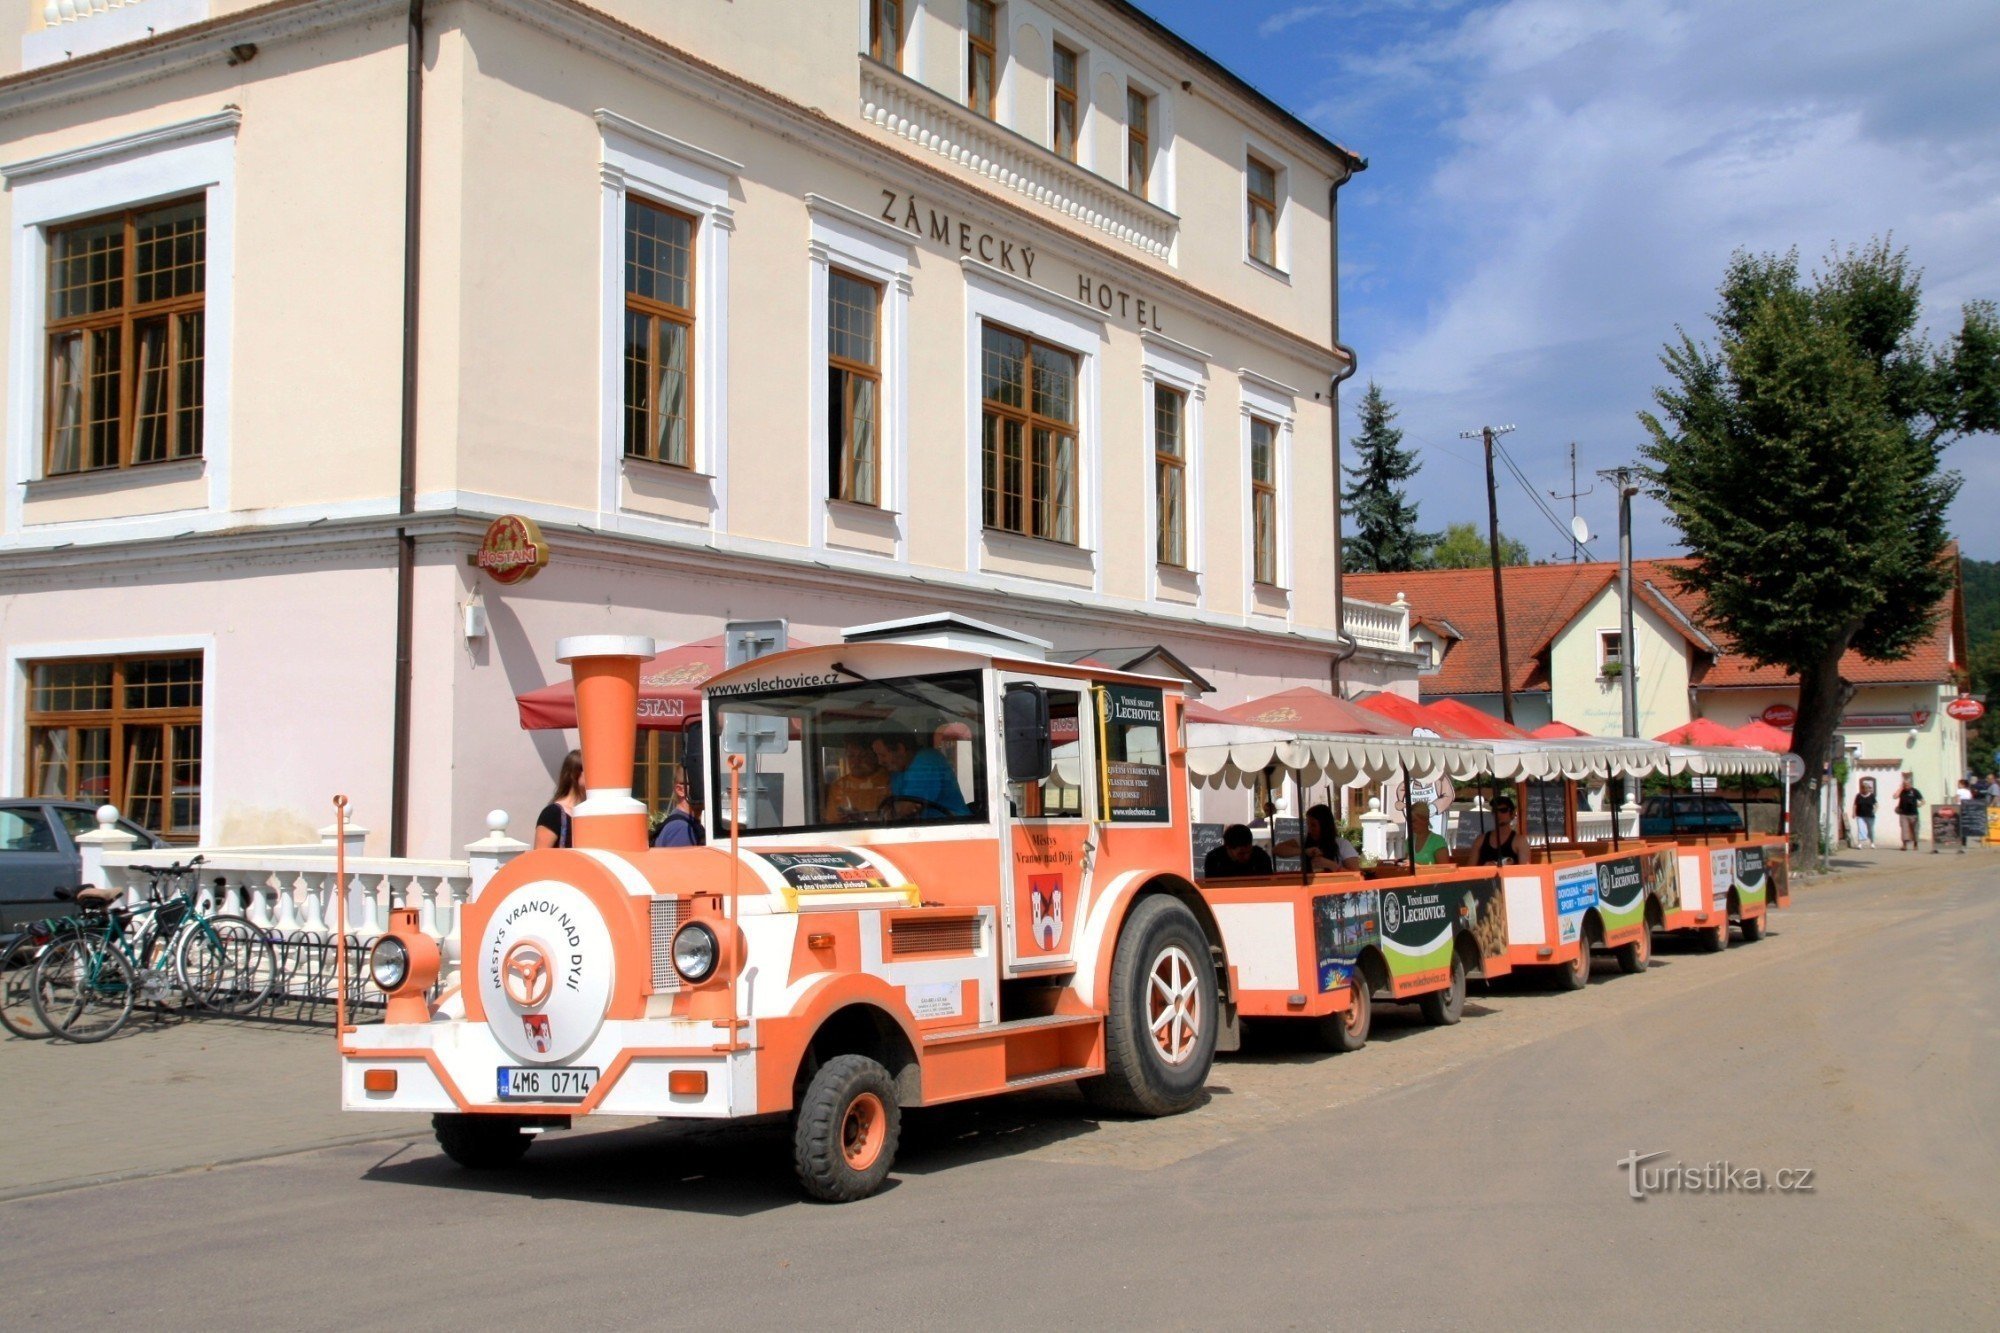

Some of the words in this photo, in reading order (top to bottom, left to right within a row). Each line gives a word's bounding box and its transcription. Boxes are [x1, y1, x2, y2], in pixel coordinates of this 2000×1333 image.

[881, 189, 1035, 278] ZÁMECKÝ
[1078, 274, 1162, 331] HOTEL
[478, 547, 536, 567] HOSTAN
[707, 672, 840, 697] www.vslechovice.cz
[636, 698, 683, 717] STAN
[1115, 702, 1161, 721] LECHOVICE
[1032, 834, 1057, 848] Městys
[1043, 851, 1057, 863] nad
[505, 900, 559, 926] VRANOV
[1402, 905, 1446, 923] LECHOVICE
[558, 912, 580, 948] NAD
[491, 927, 505, 989] MĚSTYS
[566, 954, 583, 992] DYJÍ
[513, 1072, 540, 1093] 4M6
[551, 1072, 590, 1093] 0714
